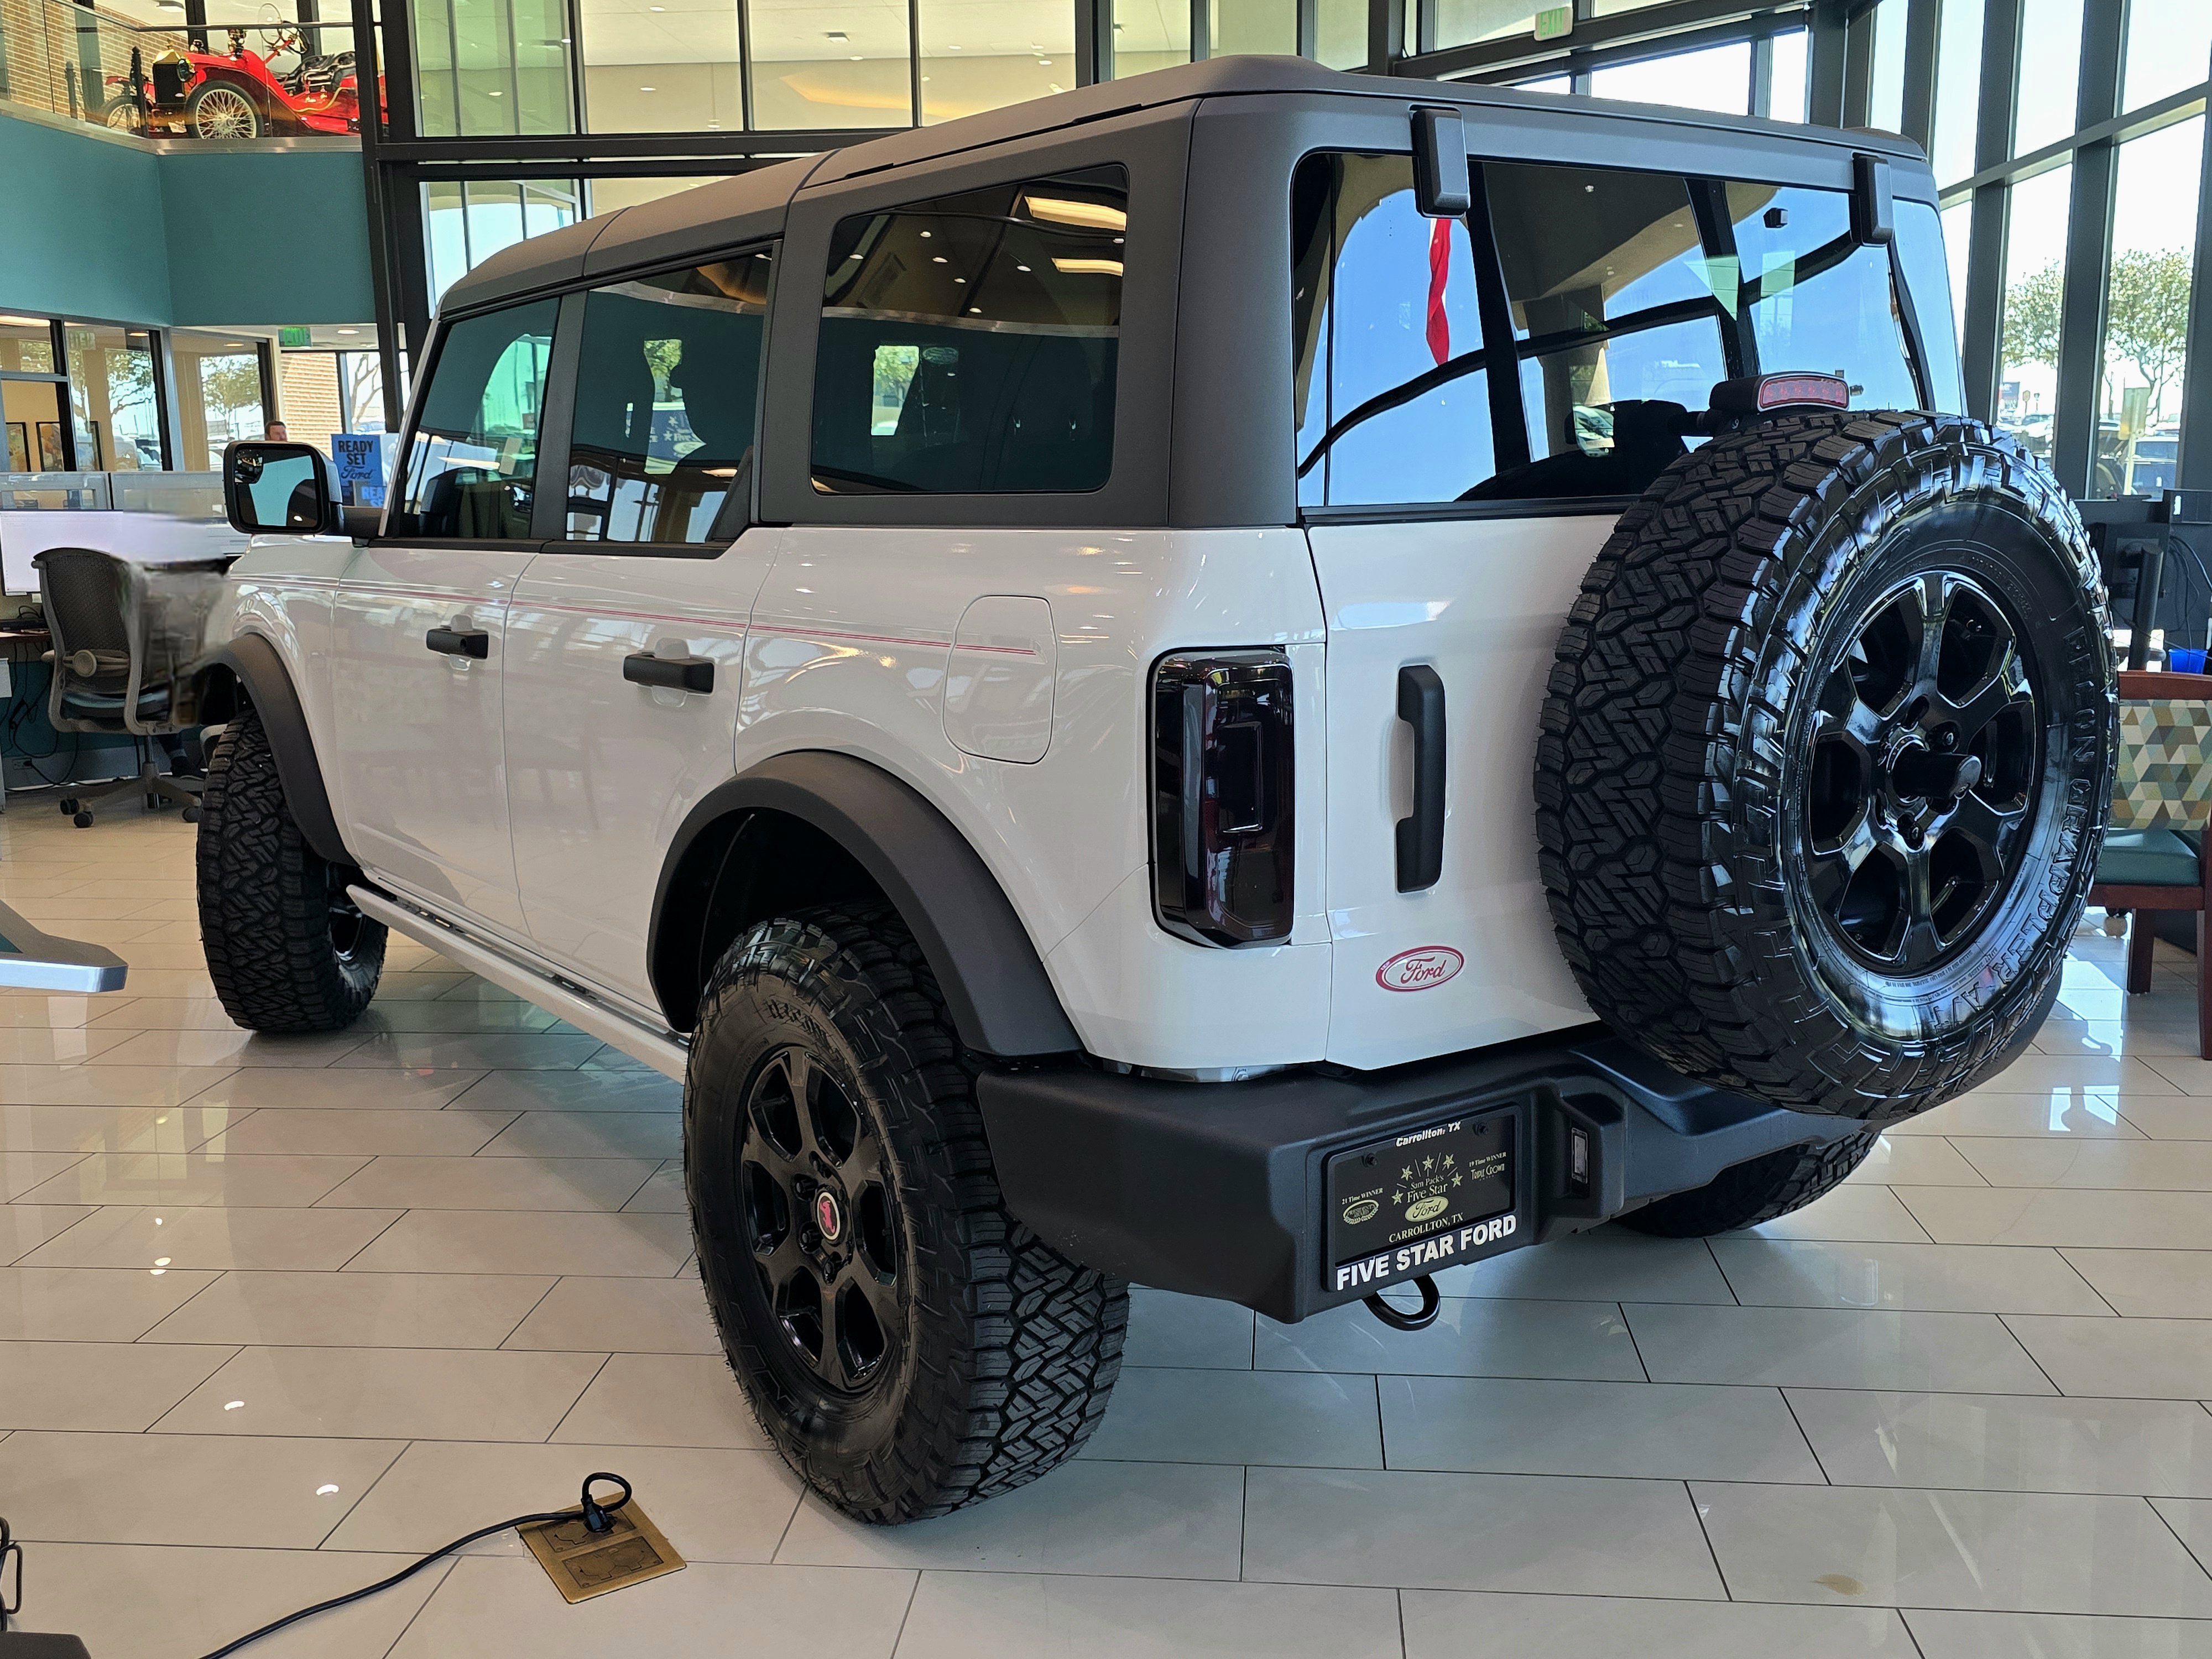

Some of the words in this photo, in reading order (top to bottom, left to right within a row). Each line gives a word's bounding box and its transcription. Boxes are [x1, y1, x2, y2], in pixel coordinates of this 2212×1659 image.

[1540, 7, 1566, 37] EXIT
[338, 440, 373, 452] READY
[347, 453, 366, 465] SET
[341, 466, 375, 479] Ford
[1992, 778, 2091, 984] GRAPPLER
[1400, 956, 1447, 984] Ford
[1396, 1128, 1446, 1147] Carrollton,
[1448, 1121, 1461, 1133] TX
[1361, 1187, 1383, 1198] WINNER
[1407, 1190, 1427, 1203] Five
[1429, 1183, 1448, 1196] Star
[1411, 1181, 1424, 1190] Sam
[1412, 1199, 1442, 1218] Ford
[1389, 1217, 1451, 1243] CARROLLTON,
[1451, 1212, 1463, 1224] TX
[1337, 1255, 1389, 1291] FIVE
[1396, 1235, 1454, 1271] STAR
[1460, 1214, 1517, 1251] FORD
